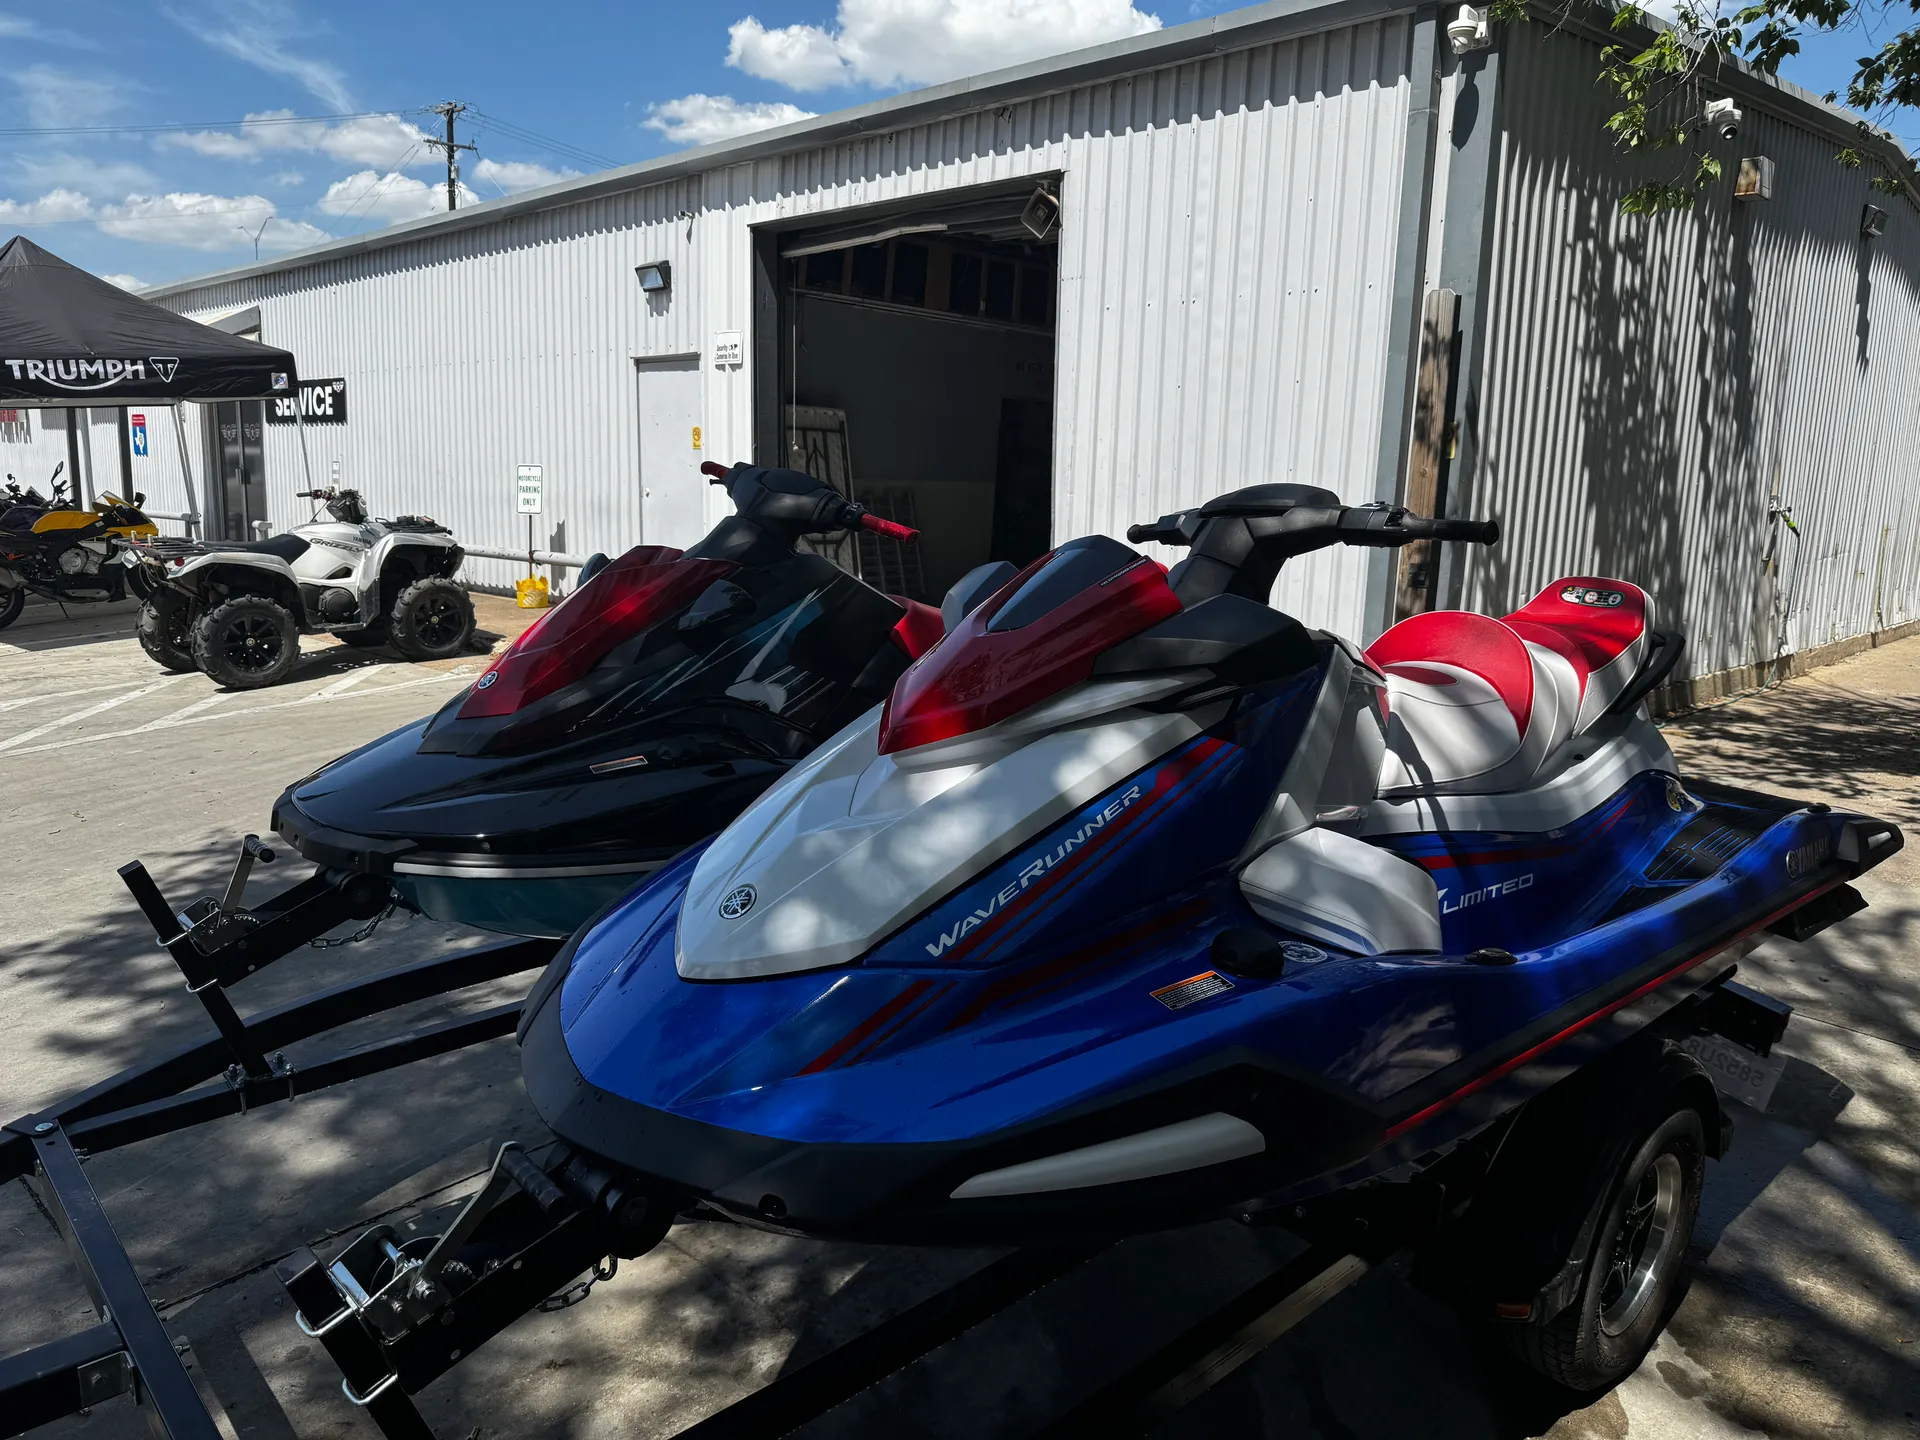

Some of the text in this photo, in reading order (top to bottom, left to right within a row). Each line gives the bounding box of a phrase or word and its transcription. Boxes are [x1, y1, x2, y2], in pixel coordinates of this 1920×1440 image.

[5, 359, 146, 390] TRIUMPH
[519, 485, 540, 494] PARKING
[522, 497, 536, 506] ONLY
[309, 538, 364, 553] GRIZZLY
[1443, 873, 1534, 914] LIMITED
